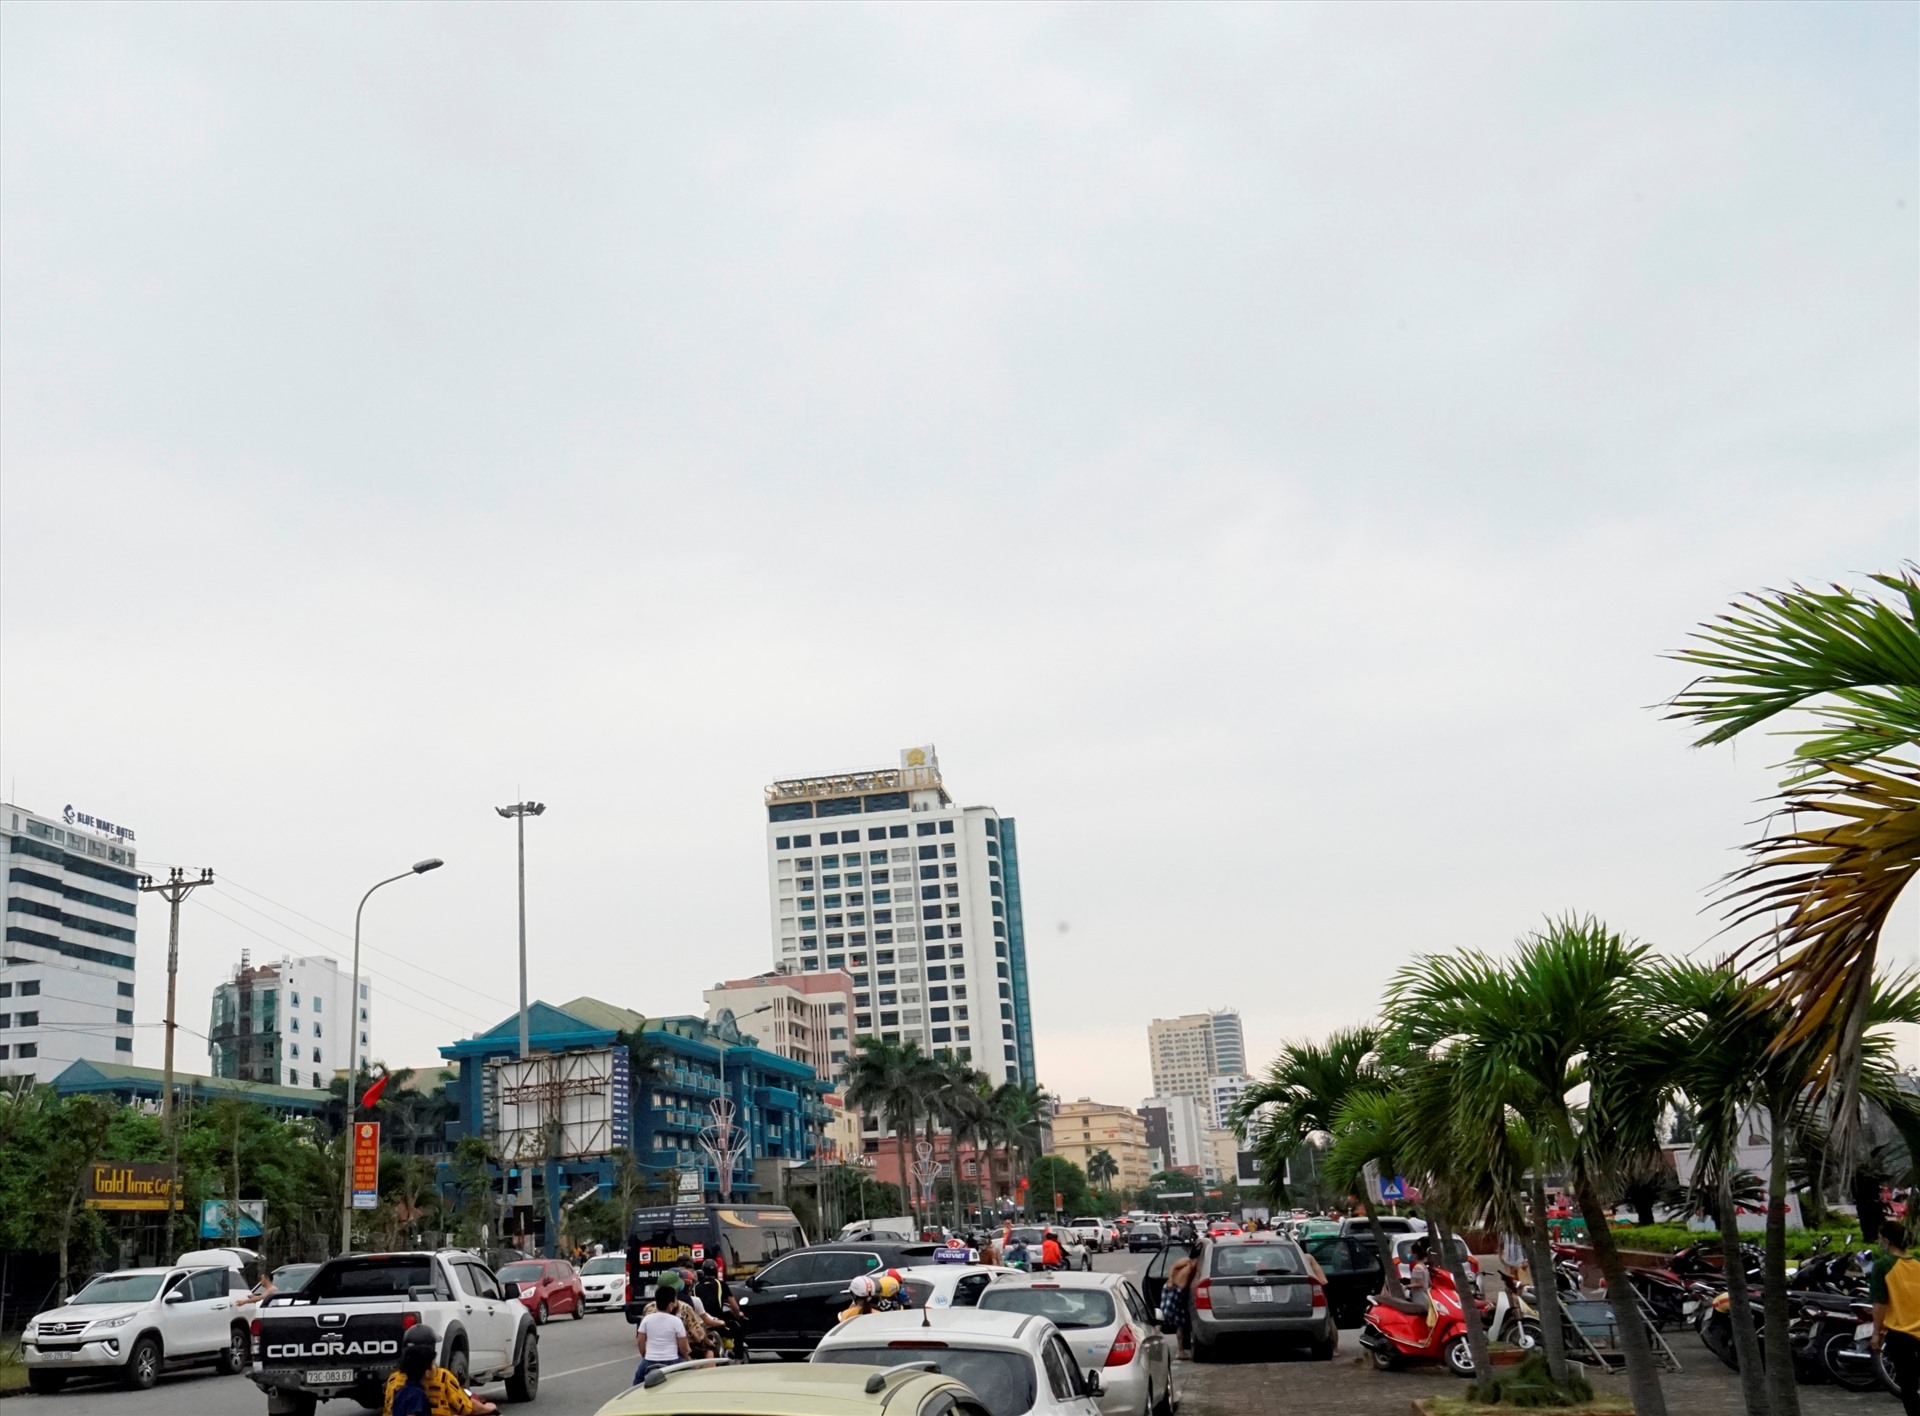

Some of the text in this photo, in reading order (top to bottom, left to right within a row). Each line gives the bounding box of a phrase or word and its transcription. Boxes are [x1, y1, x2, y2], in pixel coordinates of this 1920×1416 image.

[77, 812, 94, 827] BLUE
[95, 1167, 125, 1193] Gold
[155, 1179, 183, 1195] Cofee
[267, 1340, 398, 1358] COLORADO
